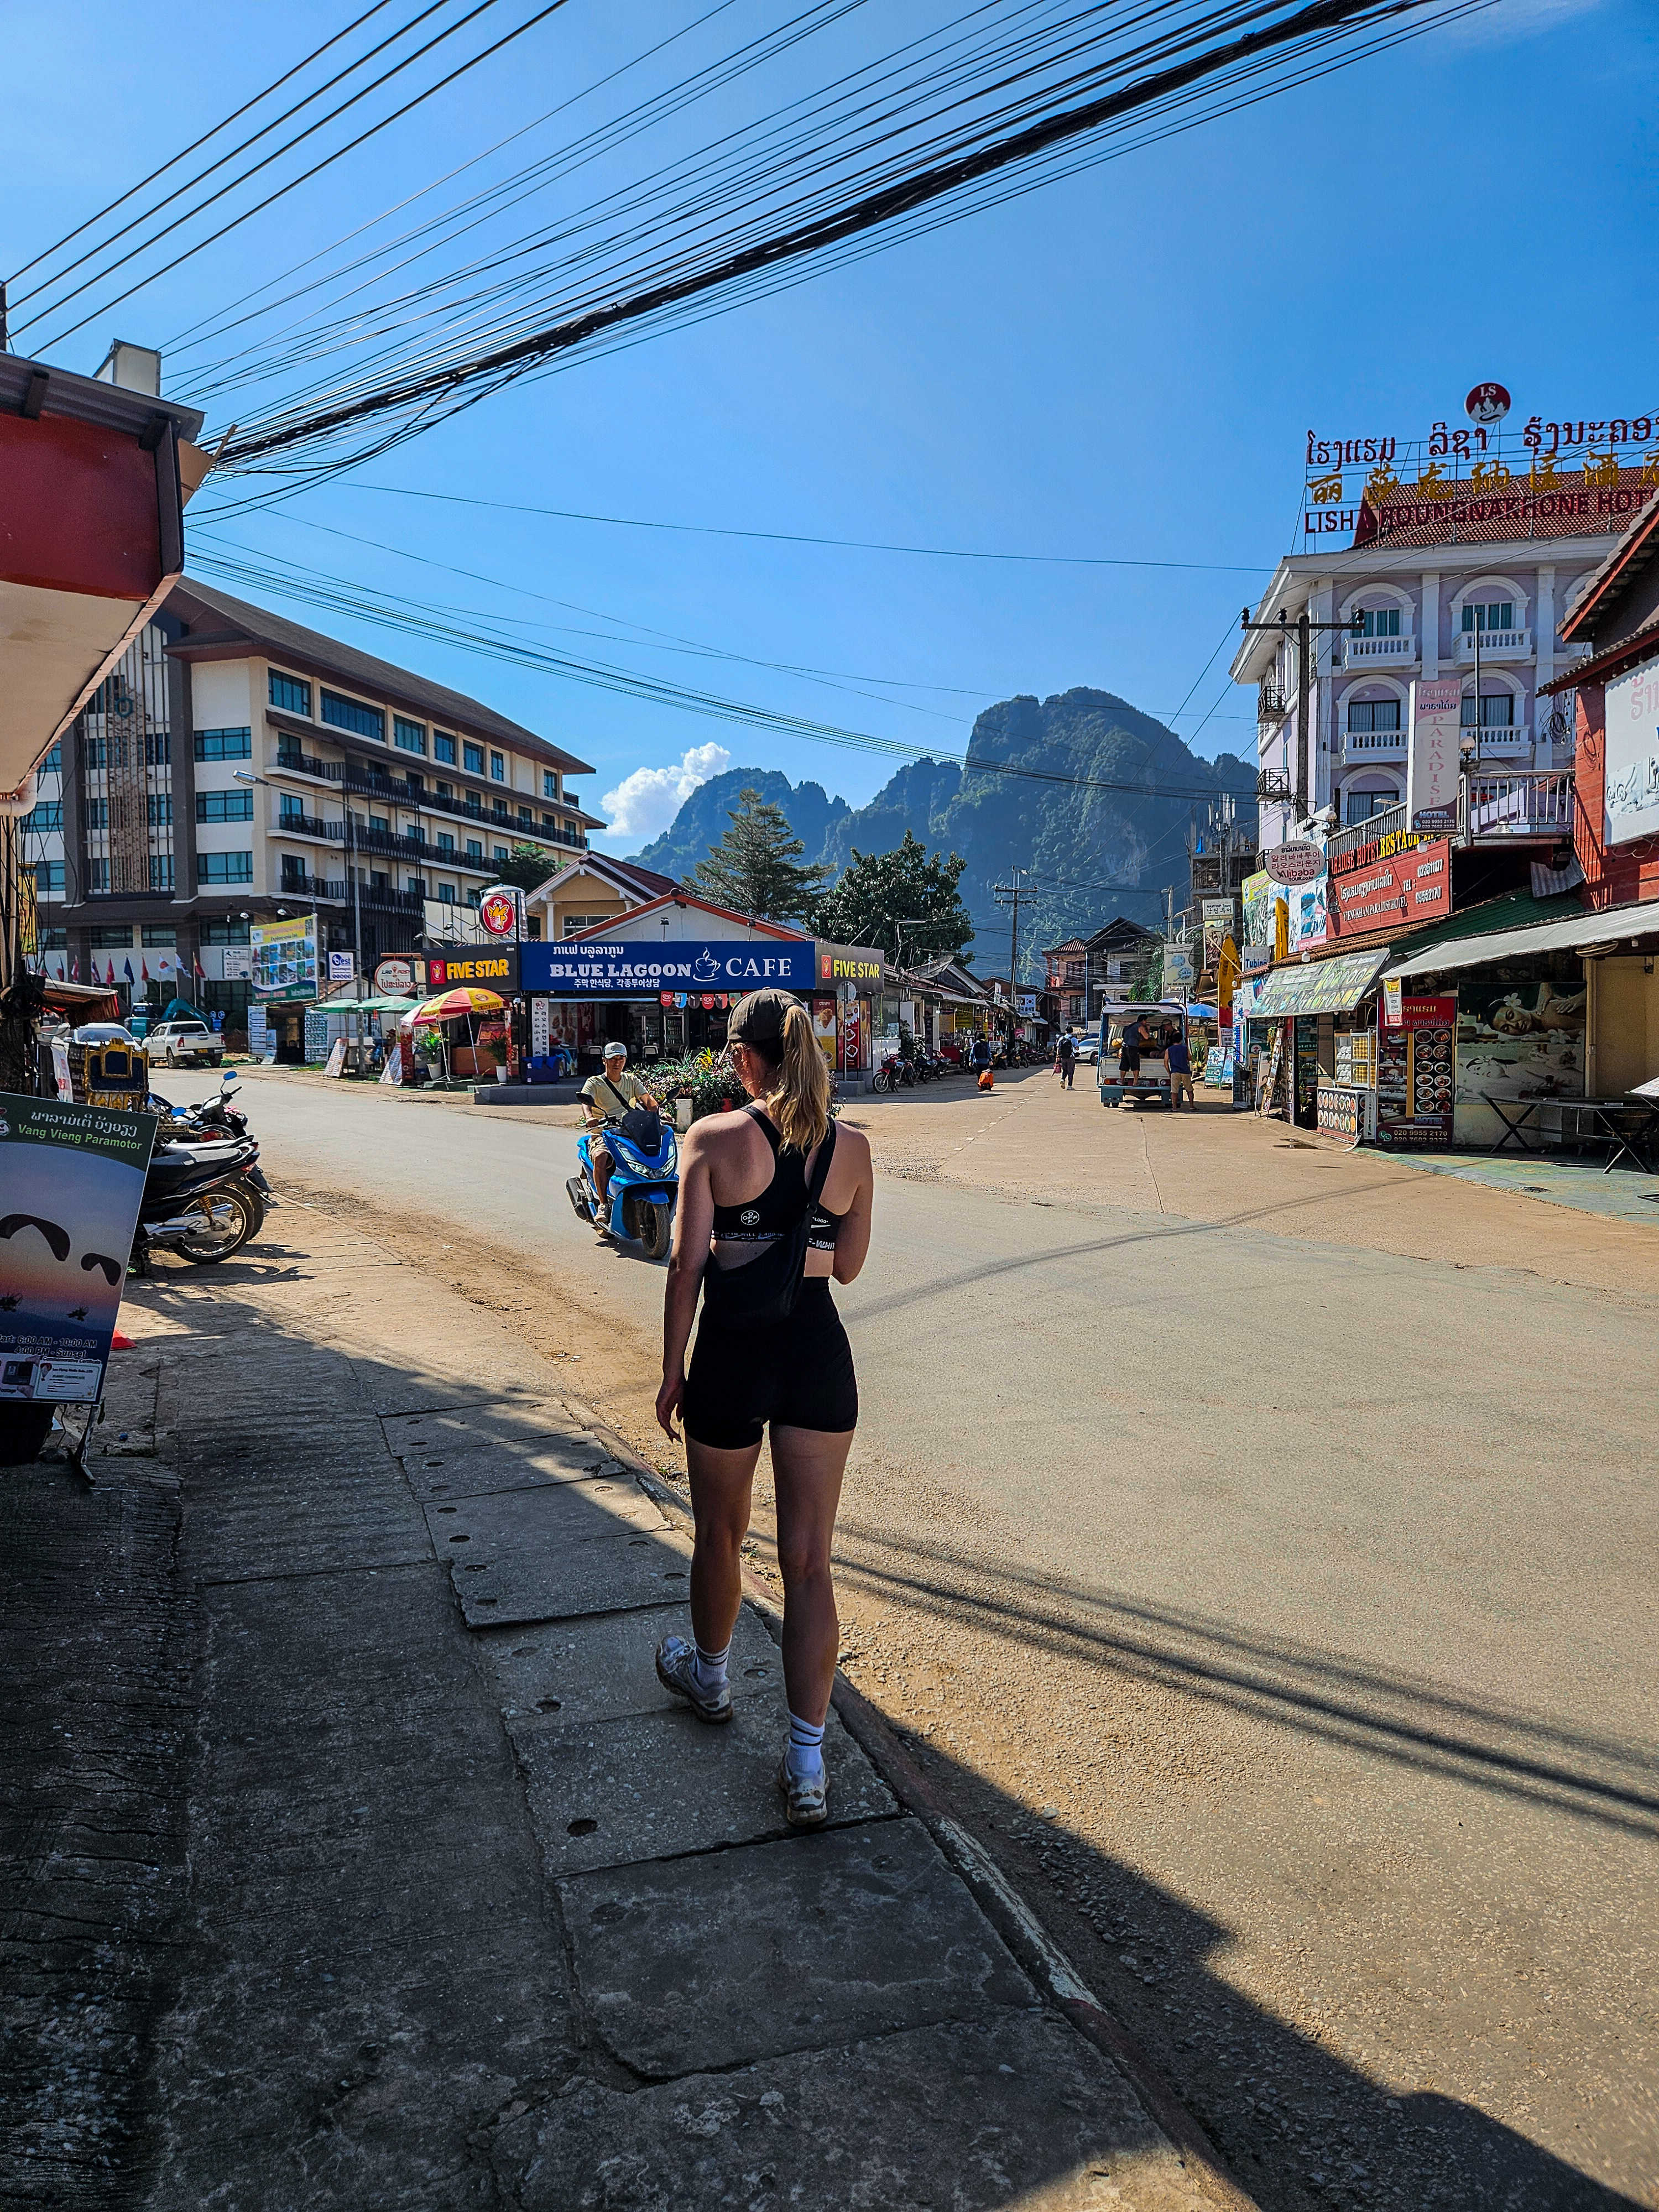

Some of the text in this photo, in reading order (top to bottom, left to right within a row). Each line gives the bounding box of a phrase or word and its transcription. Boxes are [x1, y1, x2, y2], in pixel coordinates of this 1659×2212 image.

[1480, 385, 1496, 397] LS
[1428, 716, 1444, 806] PARADISE
[1271, 851, 1320, 862] 알리바바투어
[1271, 859, 1321, 870] 라오스라운지
[1276, 868, 1315, 878] Alibaba
[447, 958, 510, 980] FIVE STAR
[550, 958, 792, 977] BLUE LAGOON CAFE
[833, 959, 880, 978] FIVE STAR
[574, 978, 589, 988] 주막
[617, 978, 660, 988] 각종투어상담
[18, 1124, 143, 1150] Vang Vieng Paramotor
[18, 1335, 36, 1344] 6:00
[37, 1337, 53, 1345] AM
[59, 1338, 82, 1347] 10:00
[83, 1339, 97, 1348] AM
[14, 1345, 34, 1355] 4:00
[35, 1347, 50, 1356] PM
[56, 1348, 87, 1358] Sunset
